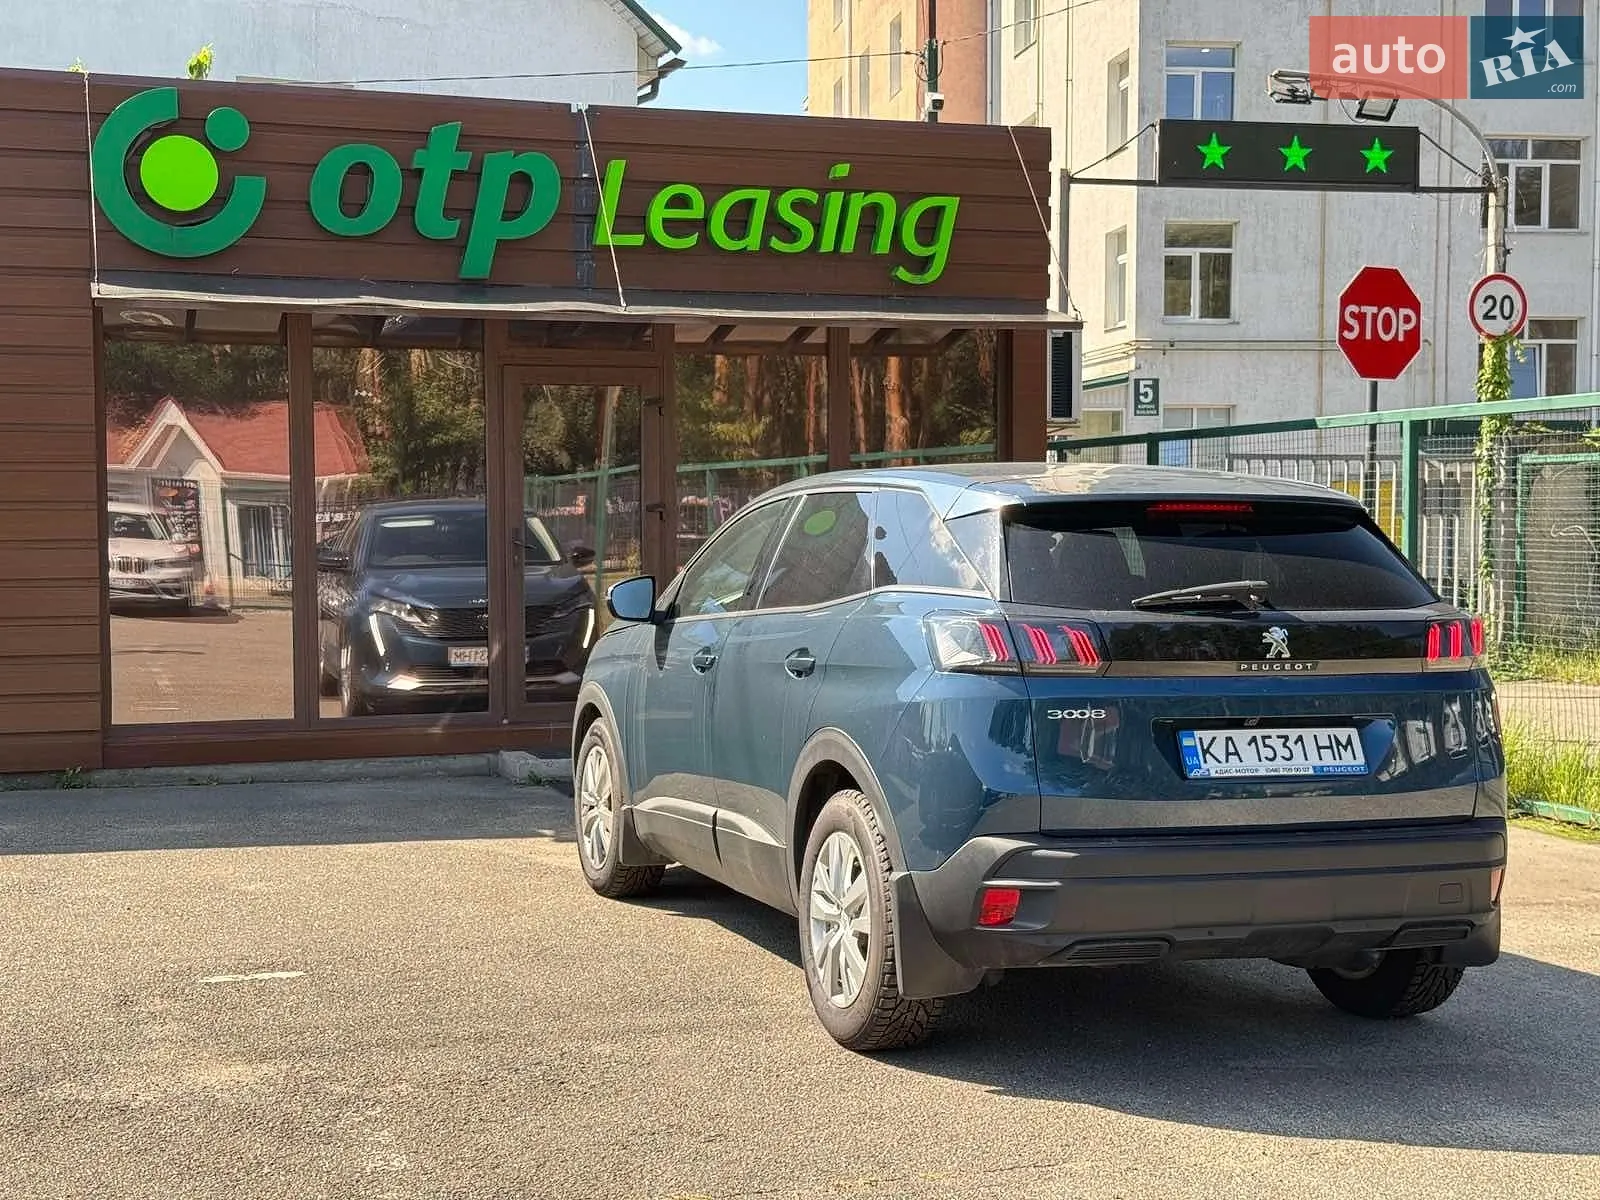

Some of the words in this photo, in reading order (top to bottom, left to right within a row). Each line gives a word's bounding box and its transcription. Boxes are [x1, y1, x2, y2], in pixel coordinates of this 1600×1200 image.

[308, 120, 562, 280] otp
[593, 159, 962, 285] Leasing
[1481, 293, 1515, 321] 20
[1342, 303, 1417, 343] STOP
[1139, 379, 1154, 403] 5
[1239, 663, 1313, 671] PEUGEOT
[1047, 709, 1107, 719] 3008
[1186, 756, 1199, 766] UA
[1198, 735, 1243, 764] KA
[1247, 734, 1309, 763] 1531
[1313, 733, 1357, 761] HM
